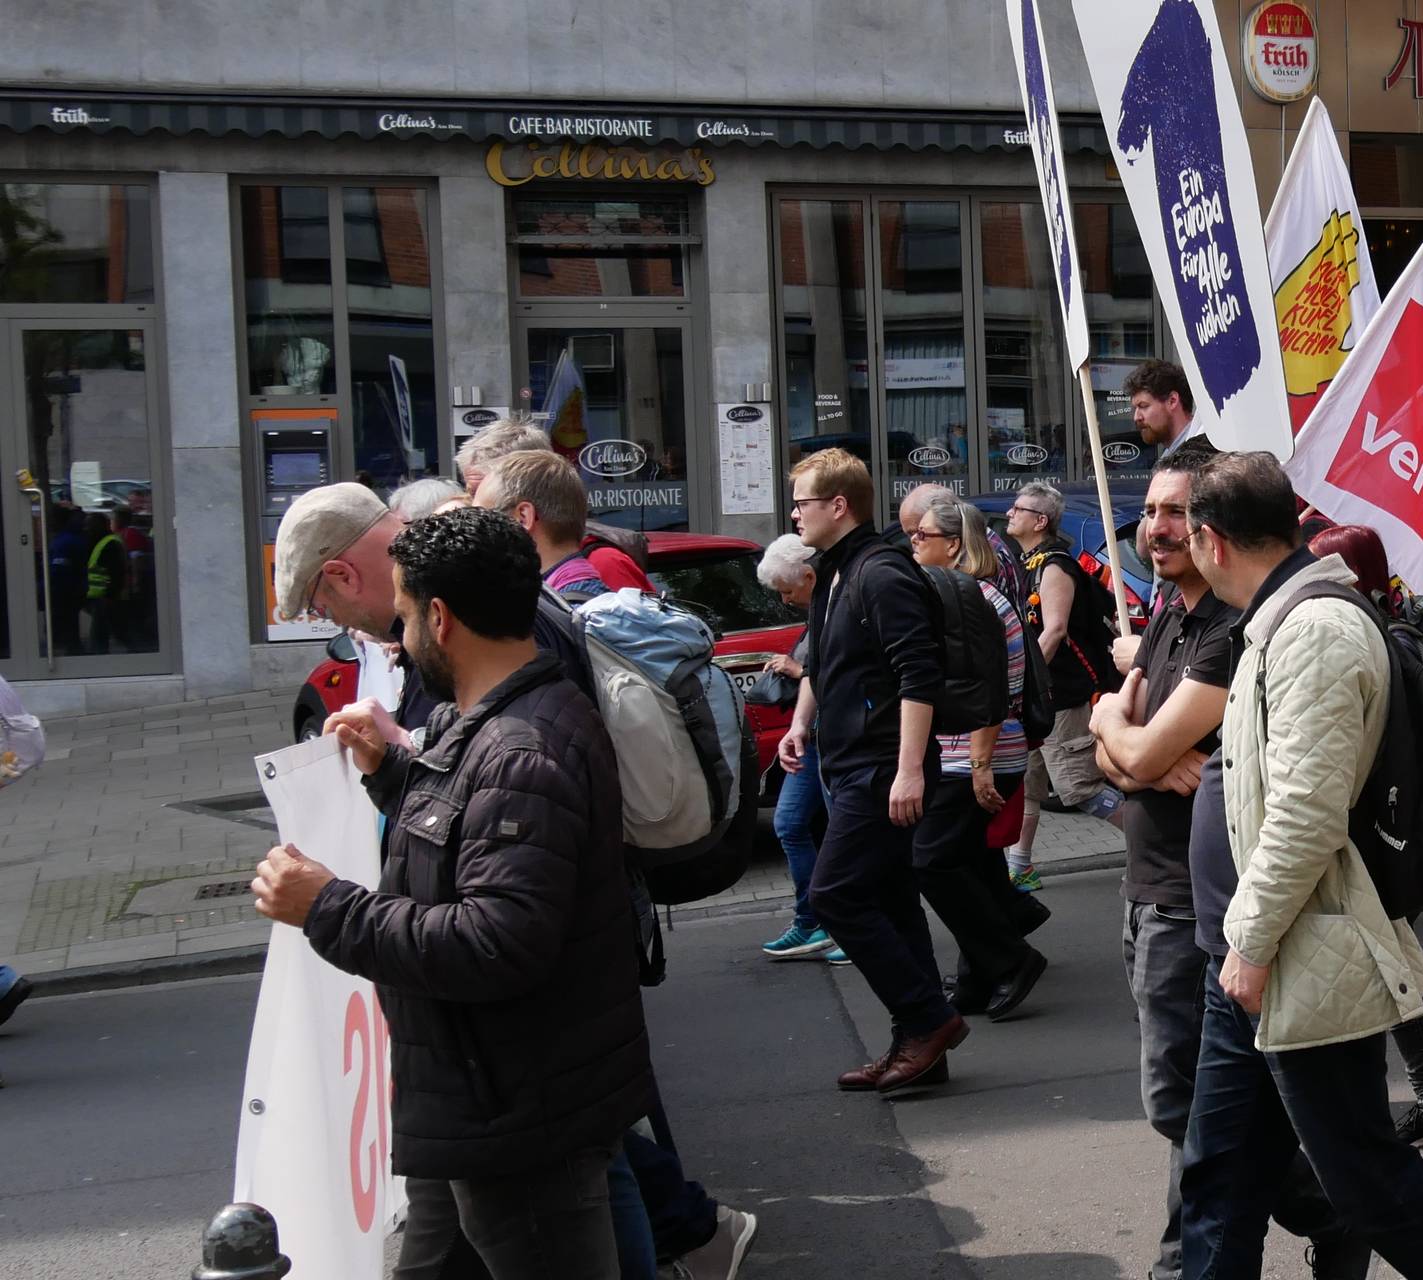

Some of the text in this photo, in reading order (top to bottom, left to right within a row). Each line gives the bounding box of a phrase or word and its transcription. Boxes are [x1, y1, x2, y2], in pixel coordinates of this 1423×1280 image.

[1261, 41, 1308, 70] früh
[50, 106, 88, 124] früh
[379, 113, 436, 131] Collina's
[697, 121, 750, 138] Collina's
[485, 142, 716, 187] Collina's
[1178, 167, 1204, 207] Ein
[1171, 190, 1224, 251] Europa
[1180, 241, 1232, 299] für Alle
[1195, 292, 1241, 347] wählen
[587, 445, 640, 468] Collina's
